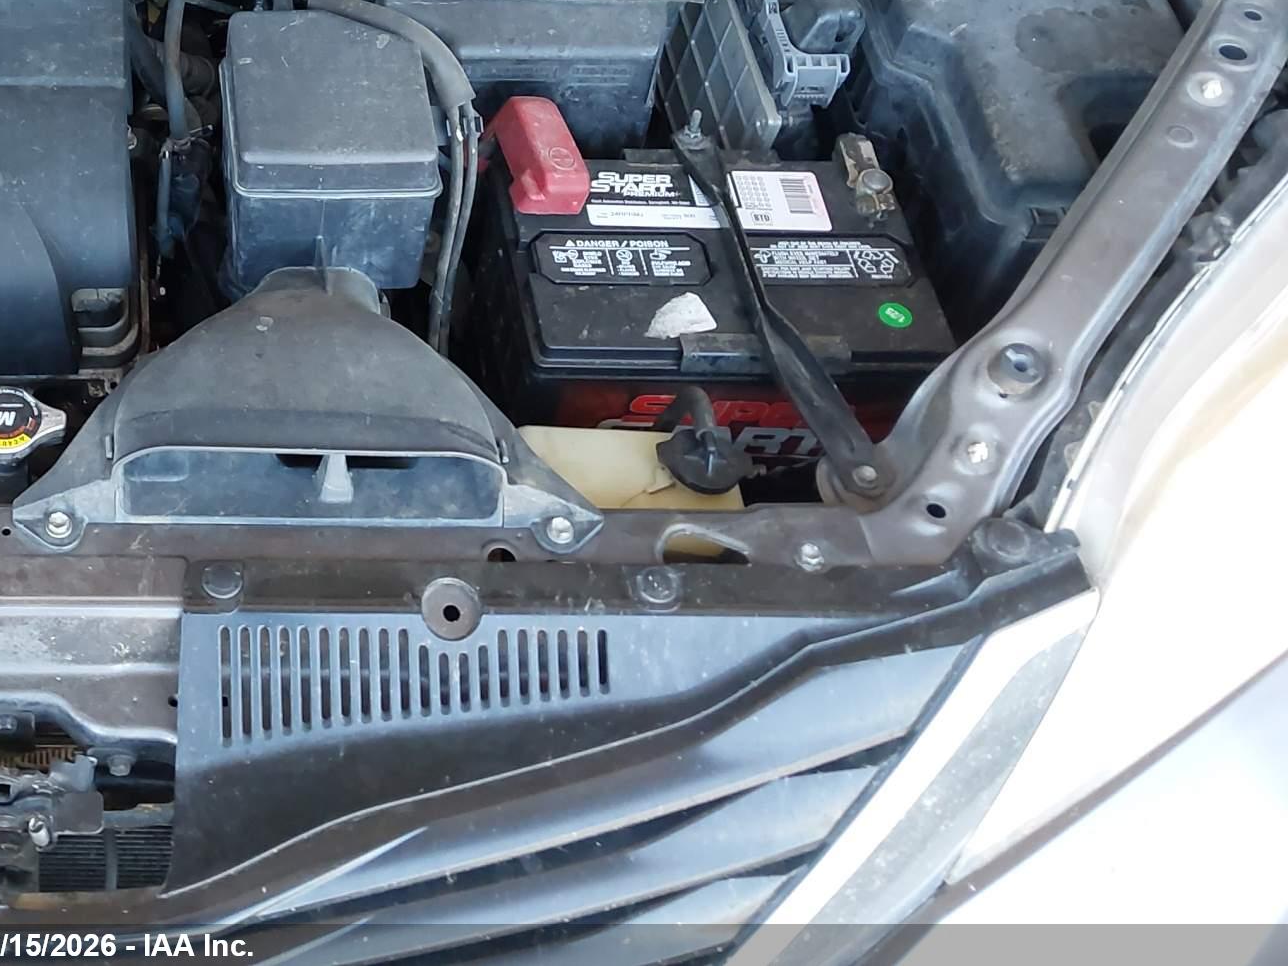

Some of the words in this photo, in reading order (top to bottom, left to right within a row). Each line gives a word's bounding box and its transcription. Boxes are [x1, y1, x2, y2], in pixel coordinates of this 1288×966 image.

[598, 171, 672, 184] SUPER
[590, 180, 674, 194] START
[576, 240, 619, 248] DANGER
[629, 240, 669, 248] POISON
